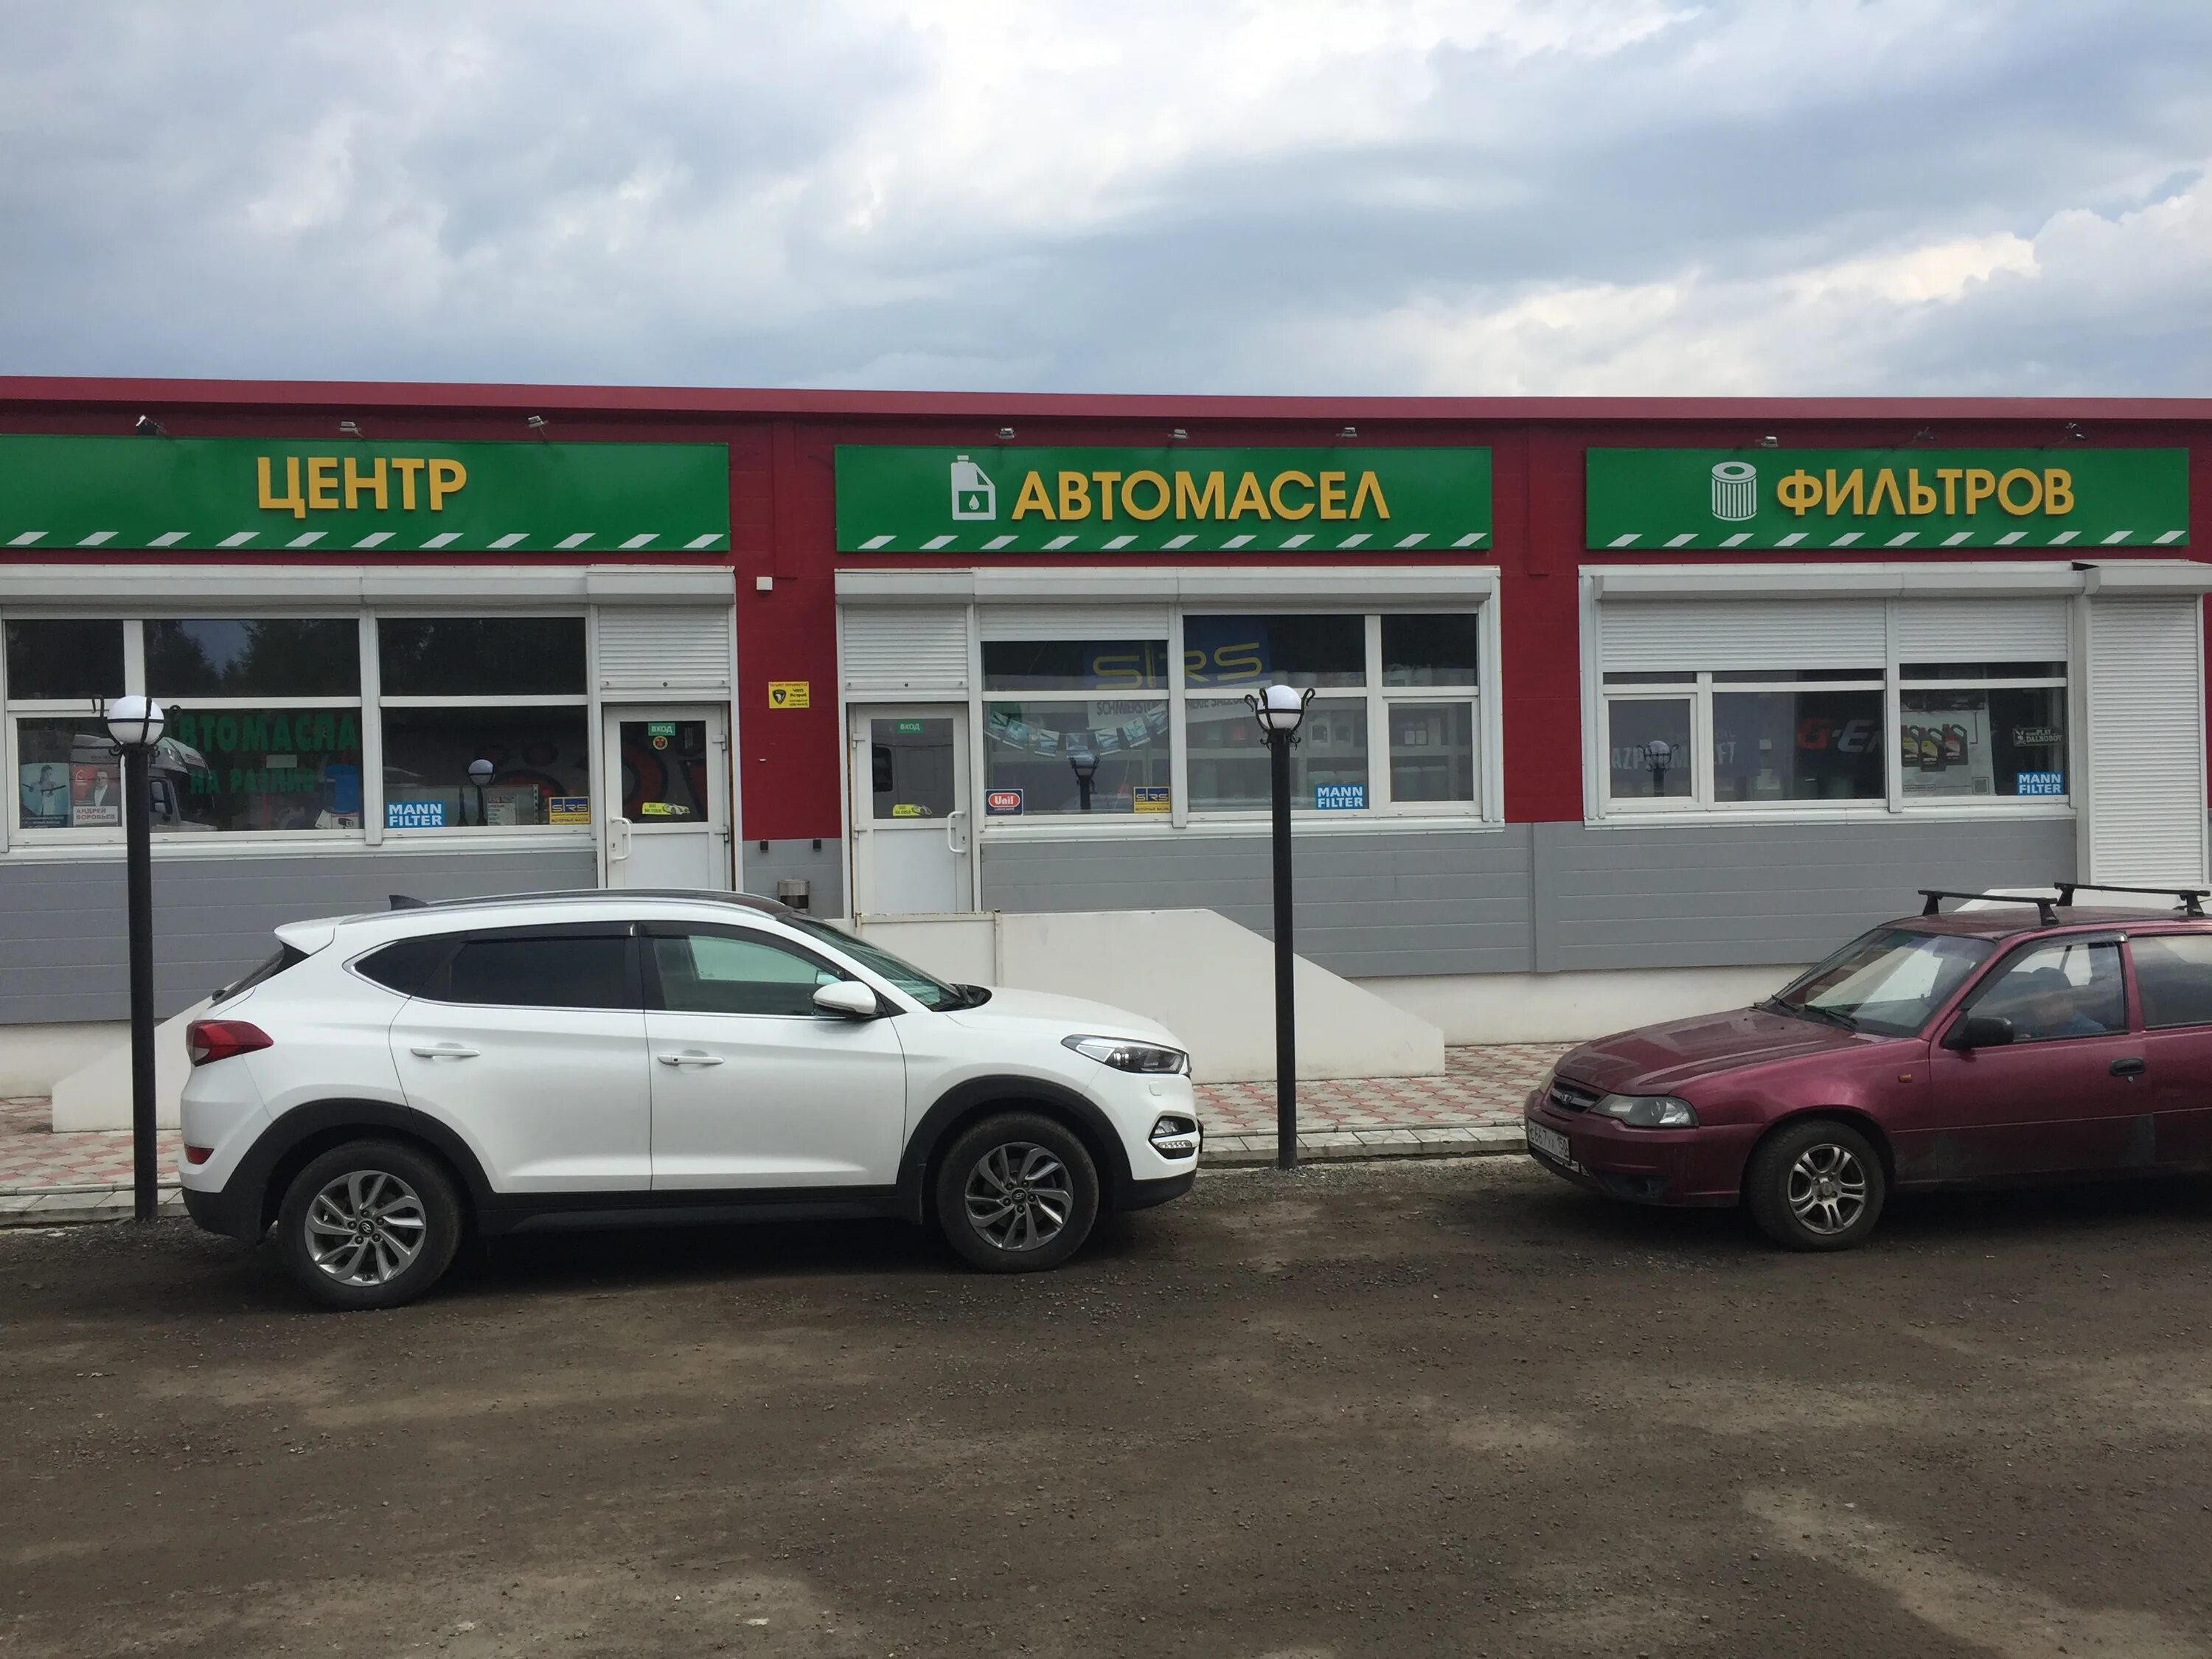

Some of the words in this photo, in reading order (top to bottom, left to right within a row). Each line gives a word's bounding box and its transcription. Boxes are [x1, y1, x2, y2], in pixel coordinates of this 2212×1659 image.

[257, 456, 467, 518] ЦЕНТР
[1777, 467, 2075, 515] ФИЛЬТРОВ
[1011, 470, 1390, 521] АВТОМАСЕЛ
[900, 723, 920, 731] ВХОД
[2019, 773, 2062, 784] MANN
[1317, 786, 1363, 797] MANN
[2019, 784, 2062, 794] FILTER
[994, 796, 1014, 805] Unil
[1318, 797, 1363, 808] FILTER
[388, 803, 442, 815] MANN
[389, 815, 442, 827] FILTER
